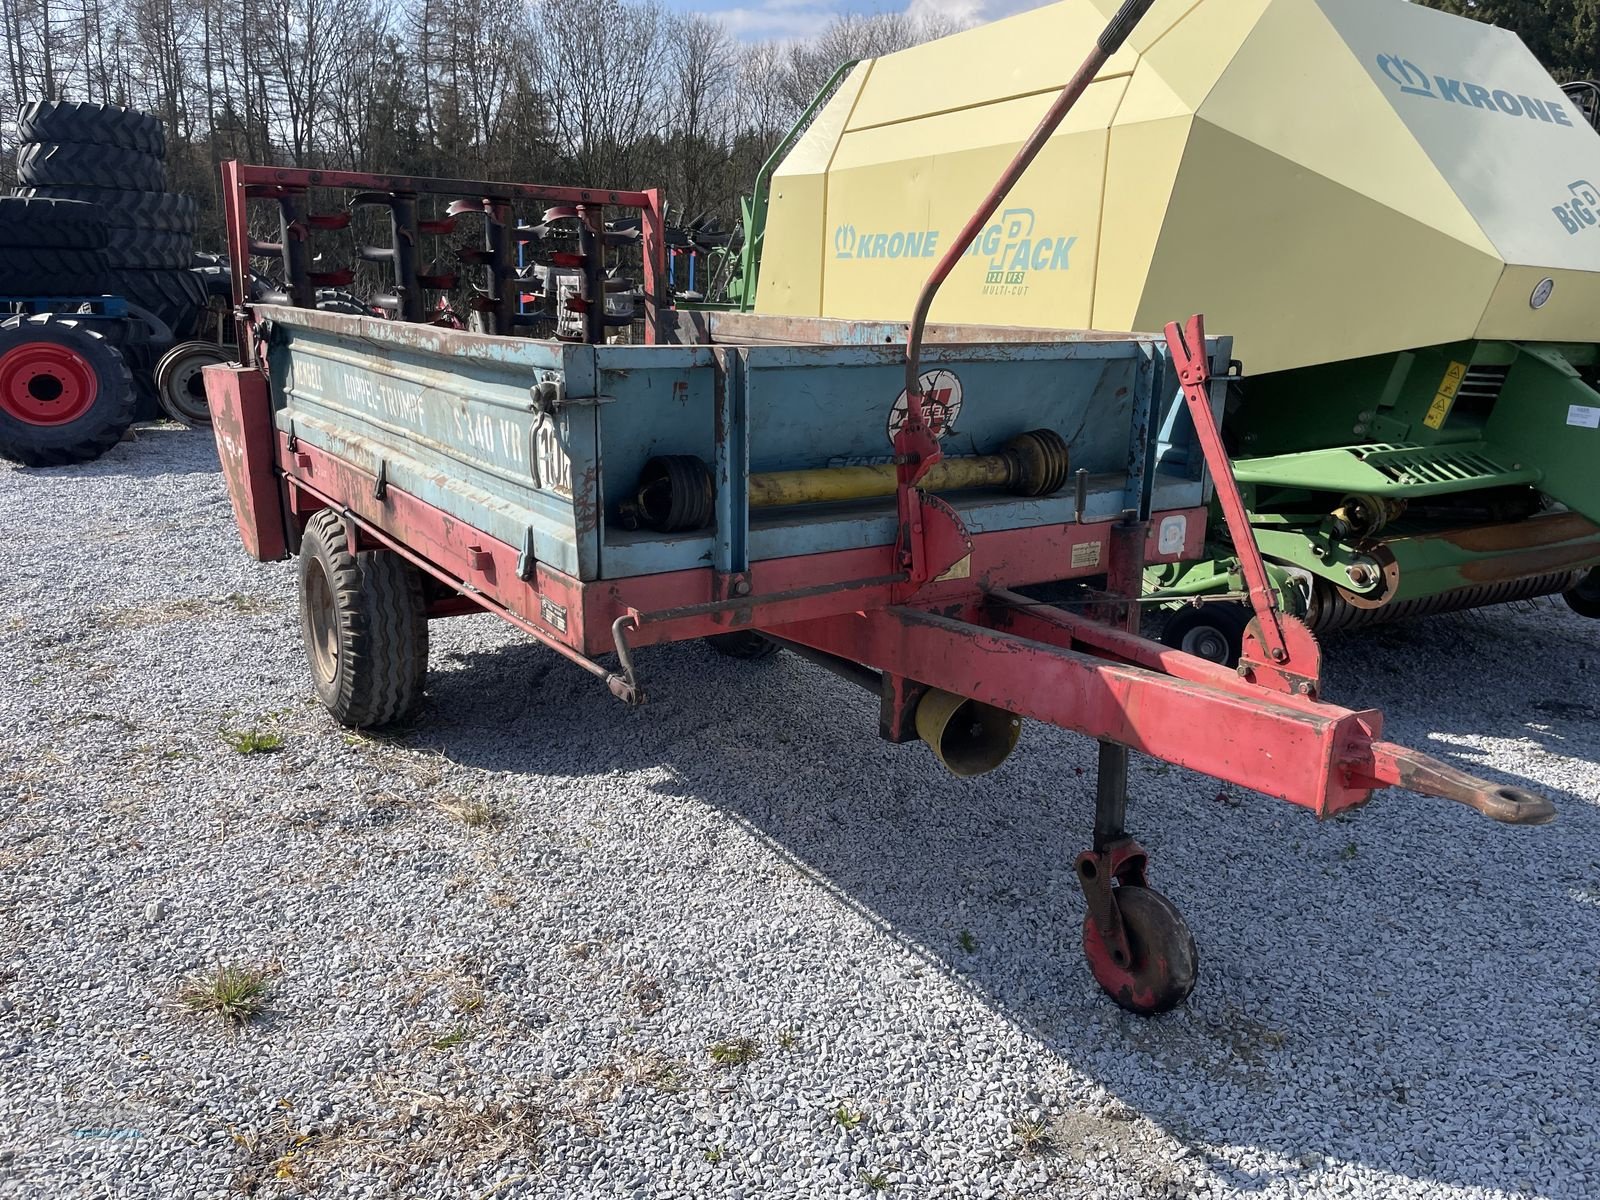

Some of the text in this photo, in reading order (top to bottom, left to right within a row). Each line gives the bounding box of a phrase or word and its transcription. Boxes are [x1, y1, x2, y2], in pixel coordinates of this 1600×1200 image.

[1433, 75, 1574, 128] KRONE
[856, 231, 939, 258] KRONE
[989, 207, 1079, 271] PACK
[982, 285, 1030, 296] MULTI-CUT
